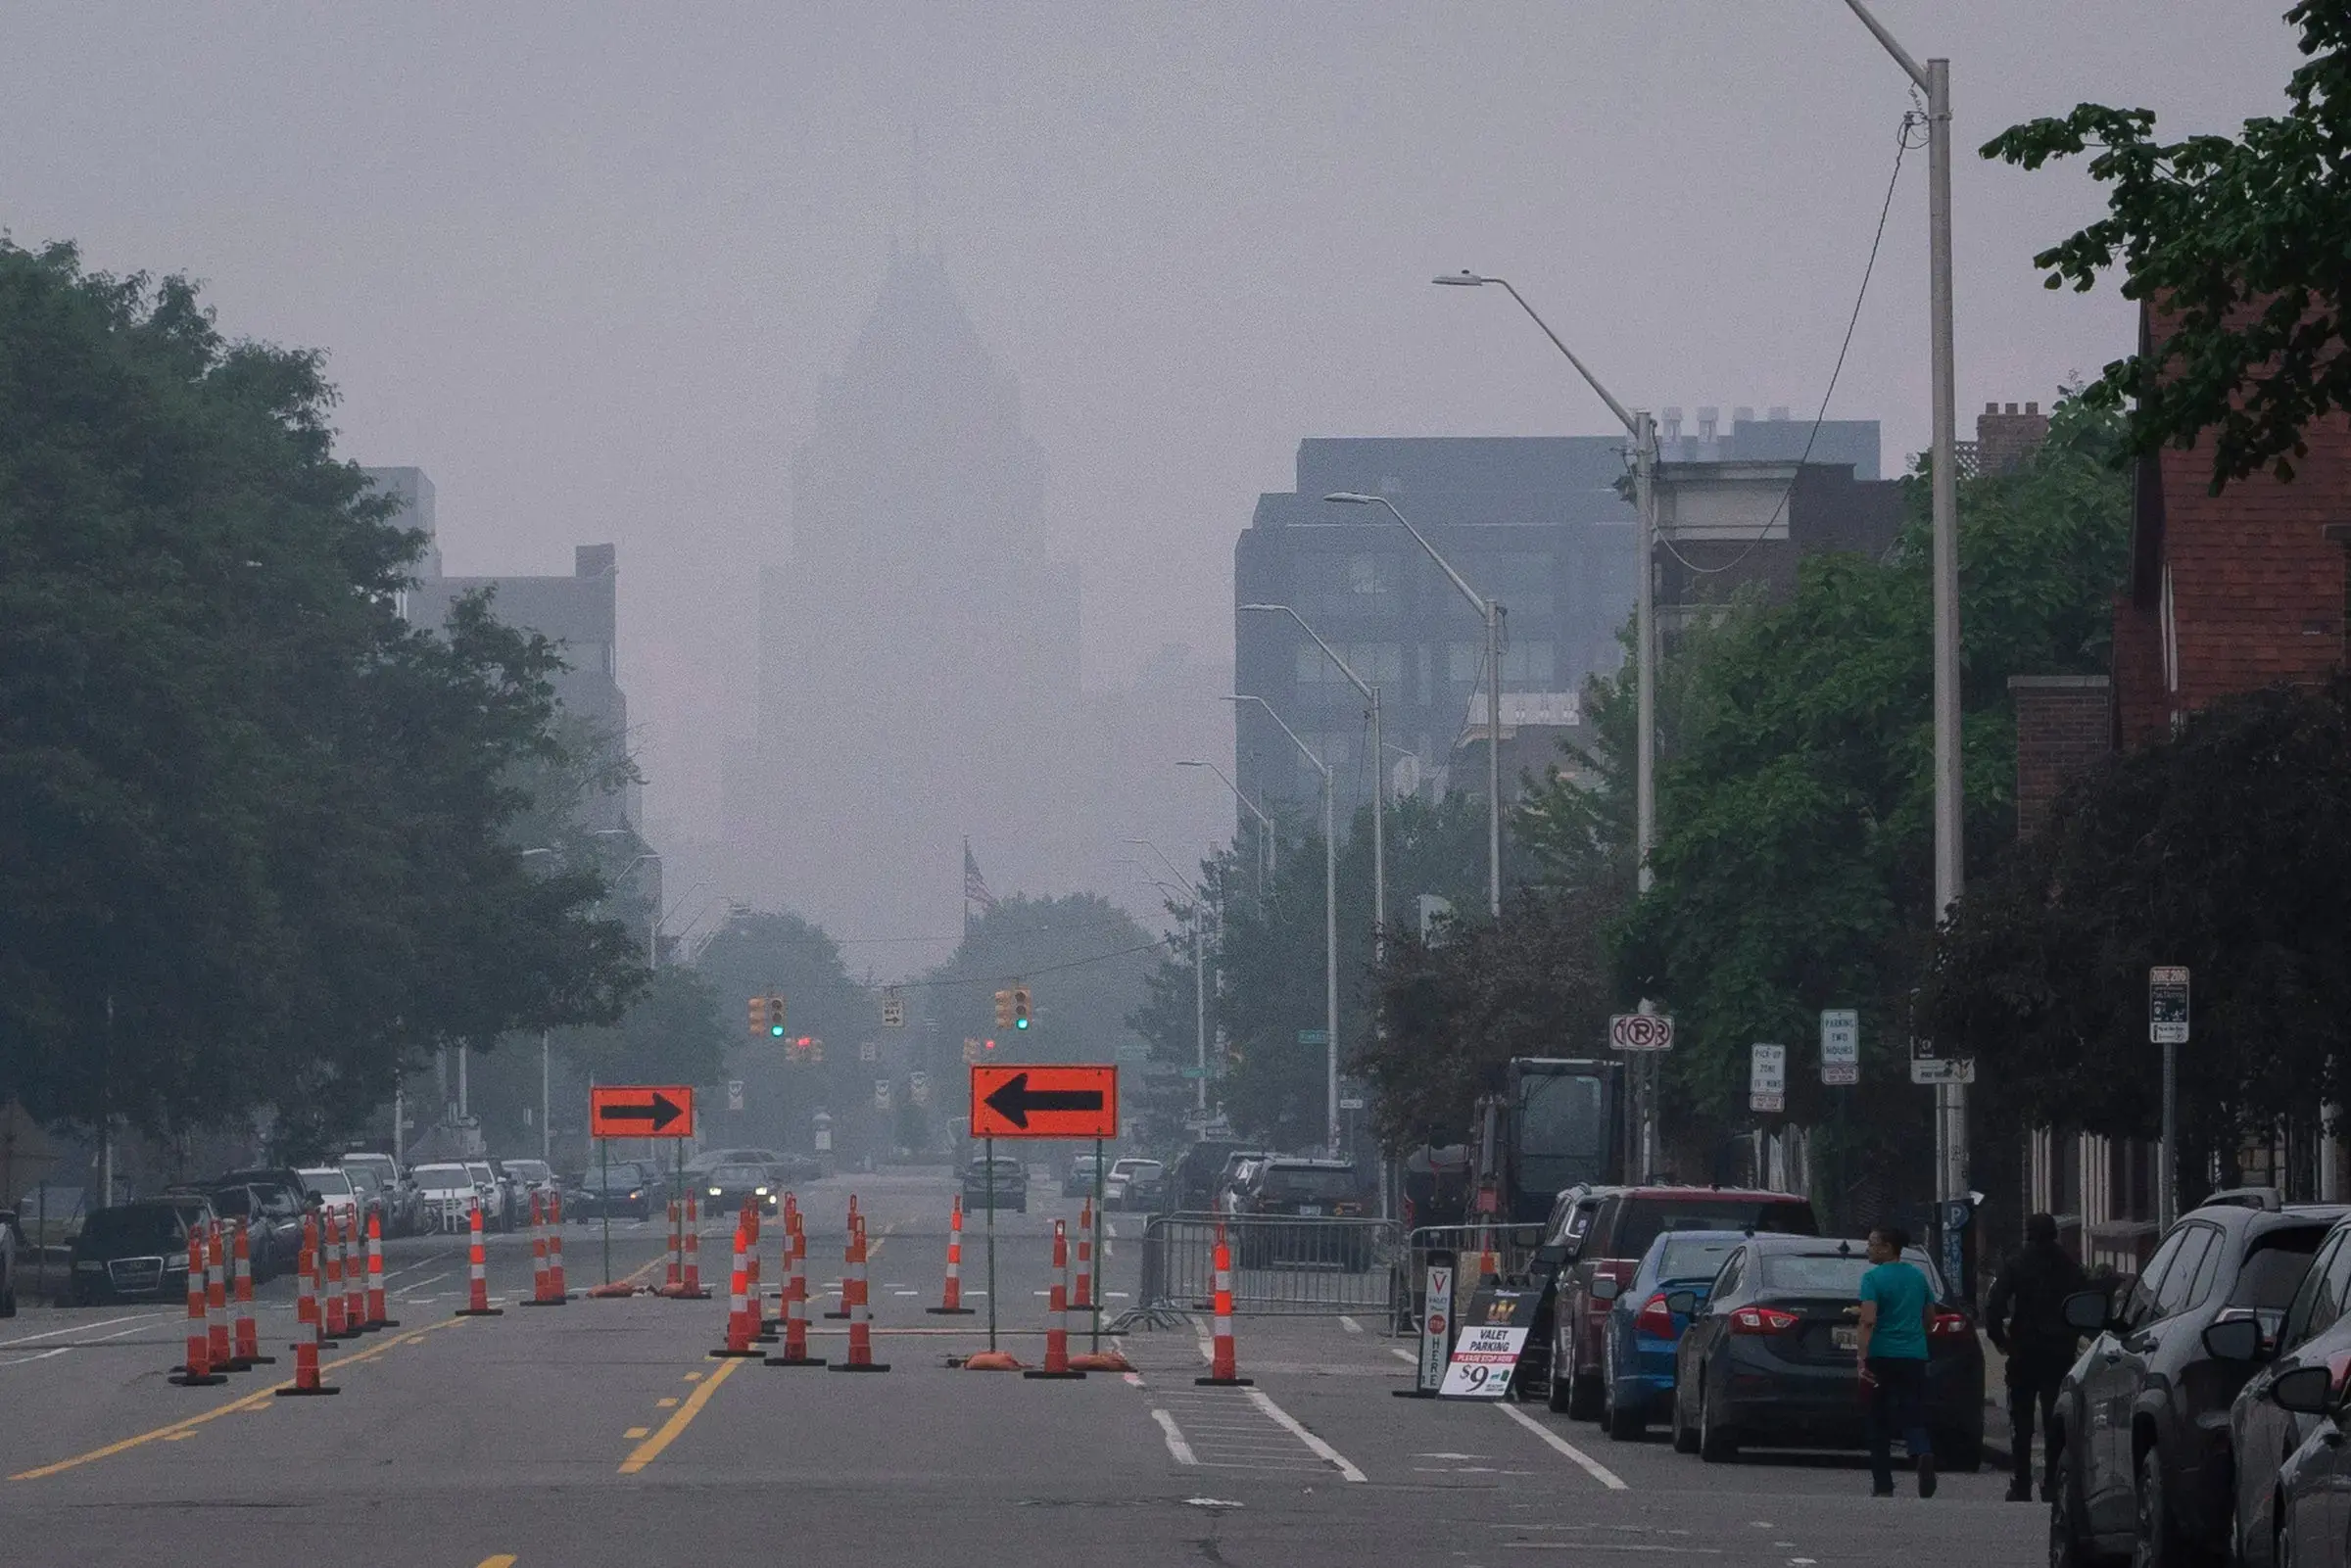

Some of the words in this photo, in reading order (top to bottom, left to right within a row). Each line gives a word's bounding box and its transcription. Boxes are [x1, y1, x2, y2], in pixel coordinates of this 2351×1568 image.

[1825, 1019, 1854, 1027] PARKING
[1832, 1033, 1848, 1042] TWO
[1754, 1049, 1782, 1059] PICK-UP
[1825, 1045, 1853, 1055] HOURS
[1479, 1329, 1509, 1340] VALET
[1469, 1341, 1511, 1353] PARKING
[1429, 1337, 1440, 1387] HERE
[1460, 1364, 1489, 1393] $9
